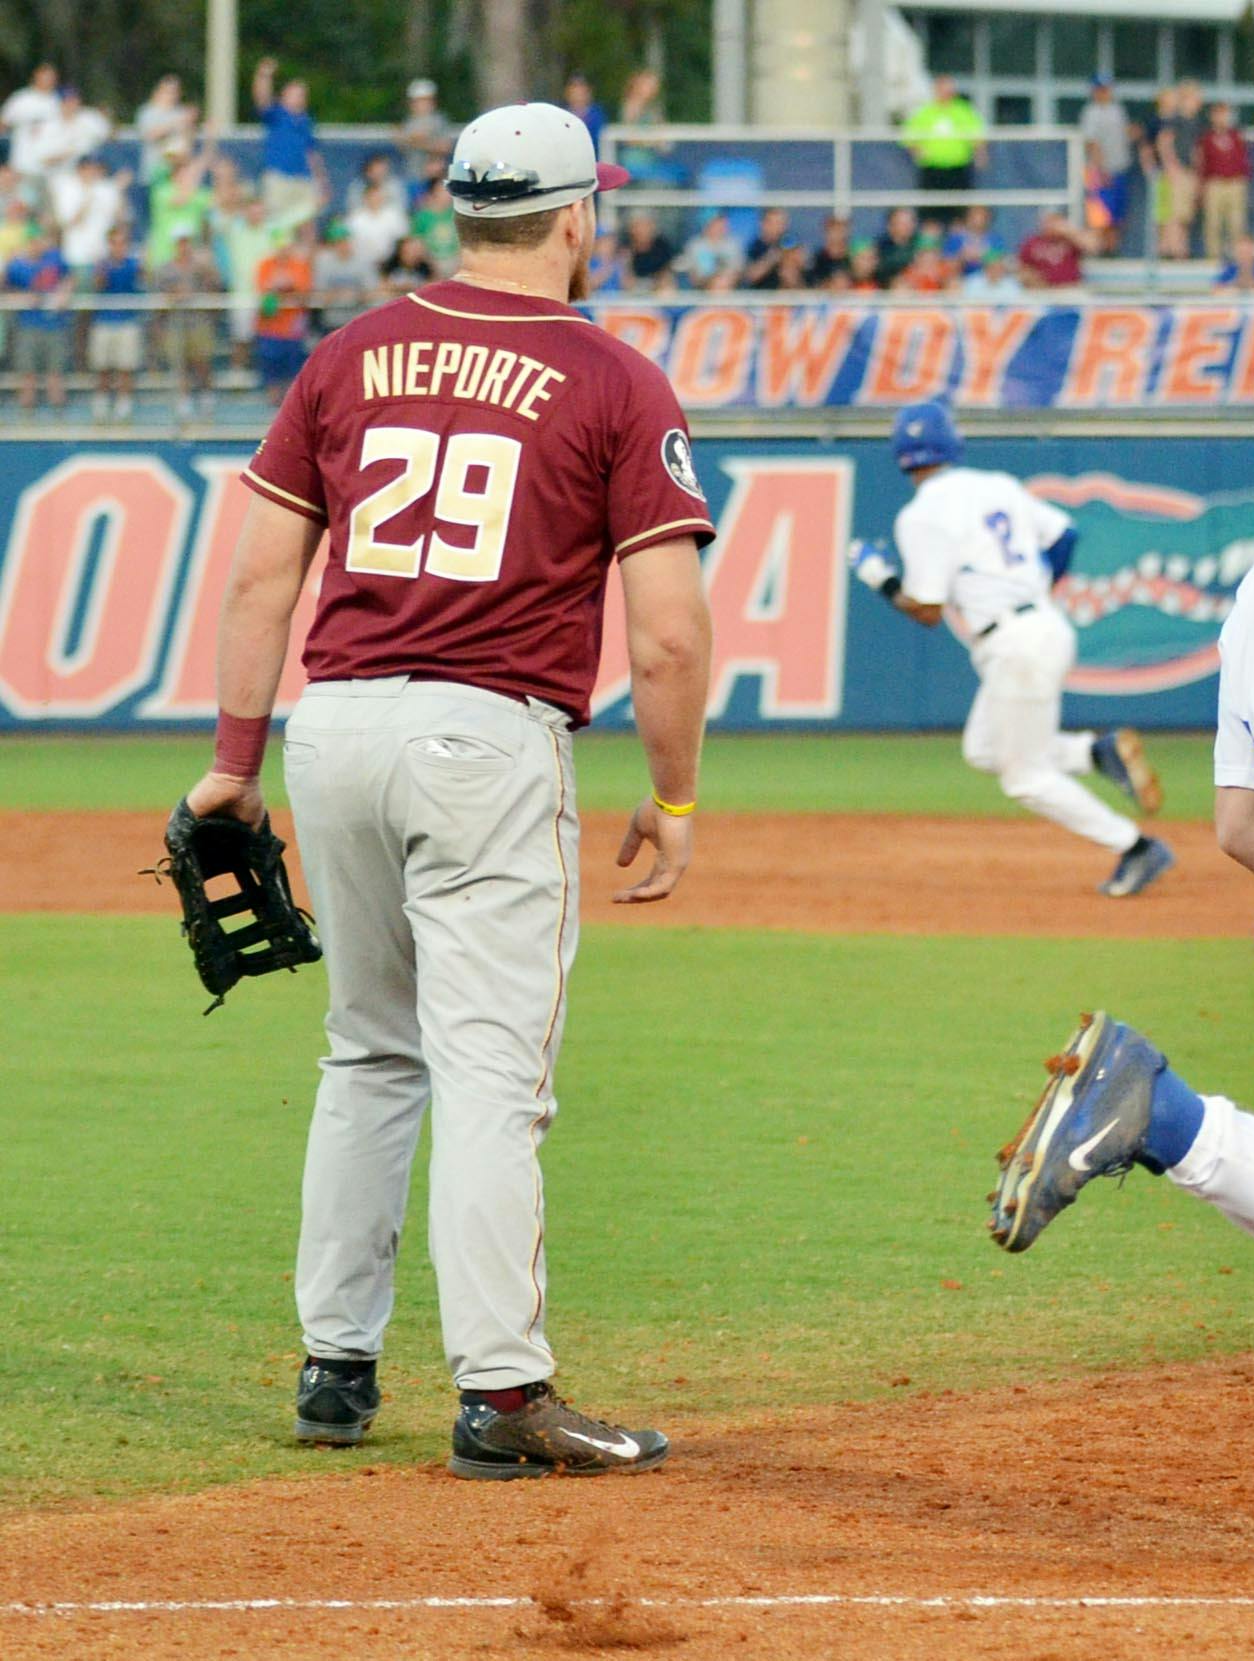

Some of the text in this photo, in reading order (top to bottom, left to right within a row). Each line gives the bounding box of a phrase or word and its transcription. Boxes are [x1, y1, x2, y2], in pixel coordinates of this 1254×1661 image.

[362, 341, 567, 422] NIEPORTE
[345, 427, 523, 583] 29
[984, 510, 1026, 569] 2
